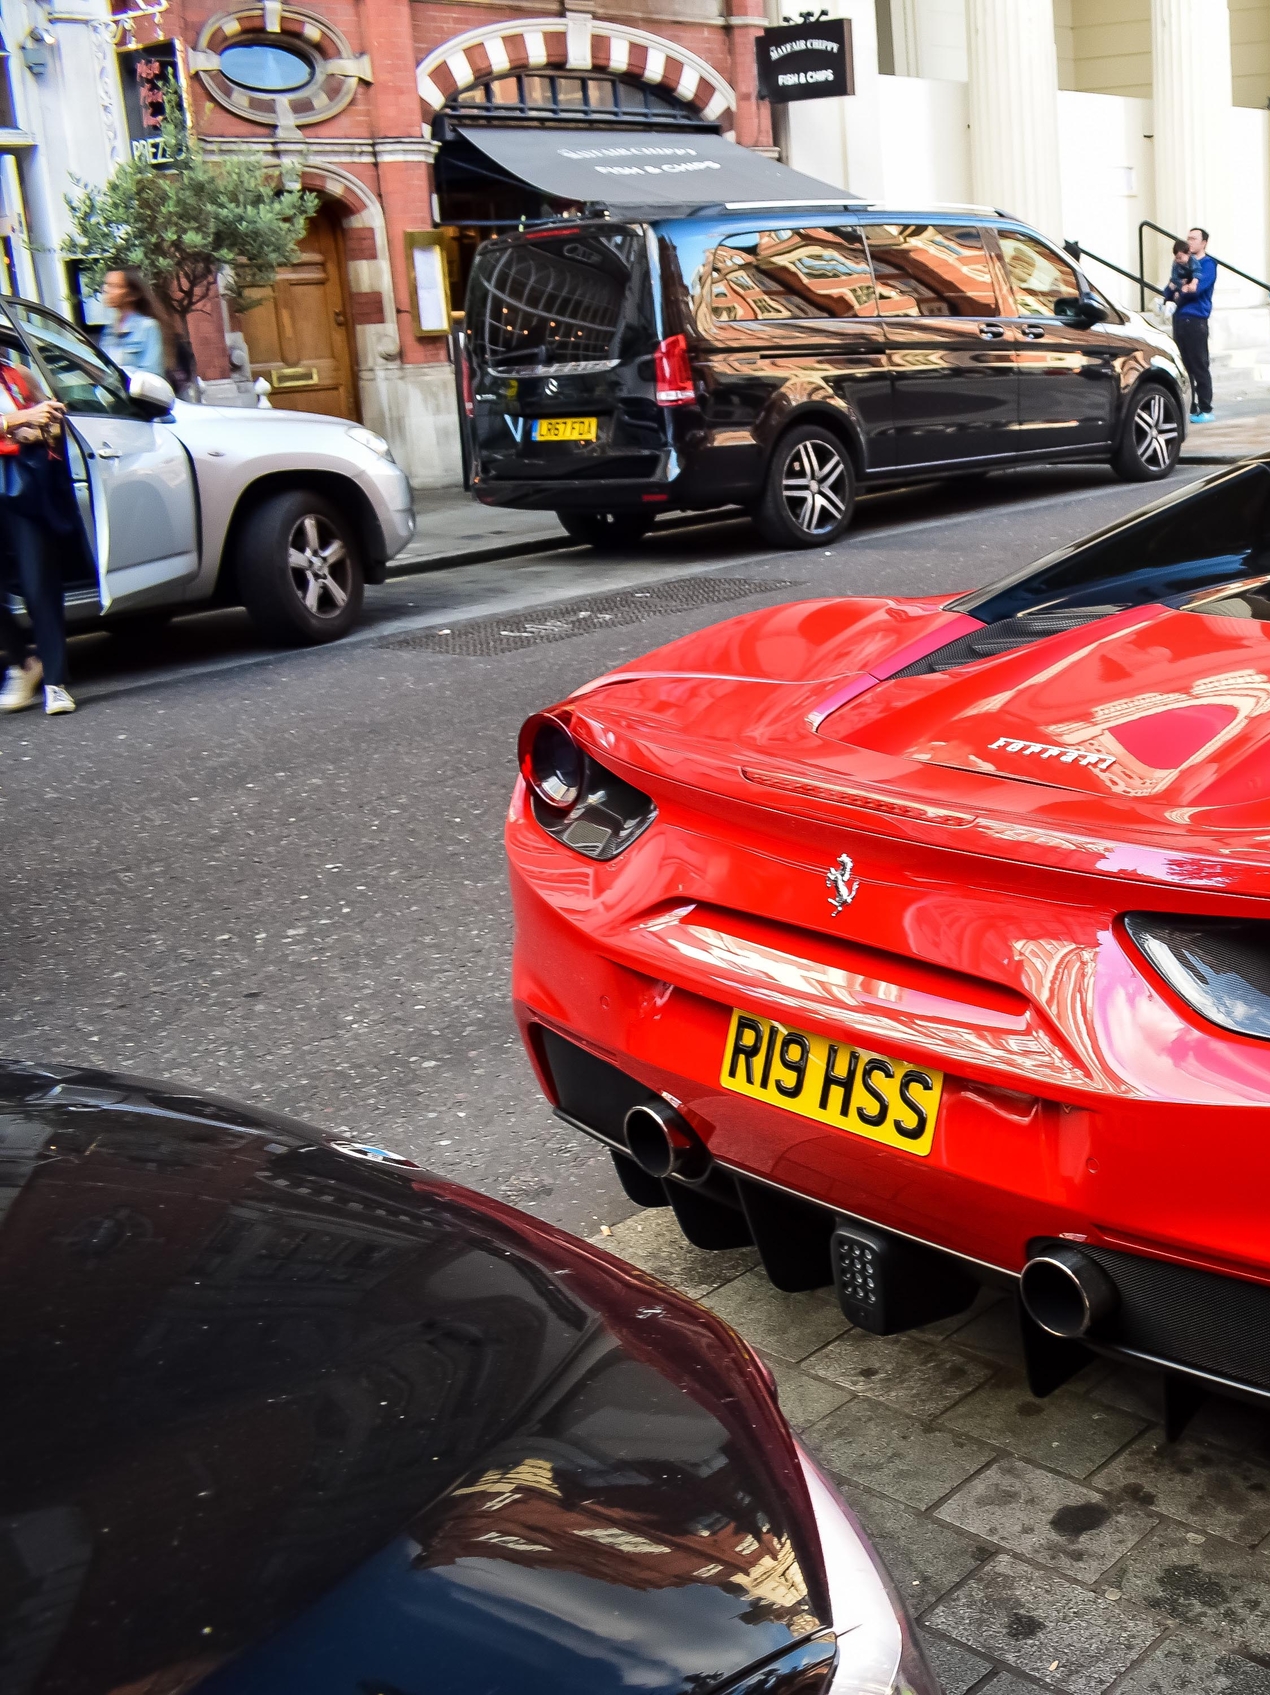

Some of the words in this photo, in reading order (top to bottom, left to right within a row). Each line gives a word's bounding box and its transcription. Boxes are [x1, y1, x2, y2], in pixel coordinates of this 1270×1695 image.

[778, 73, 798, 86] FISH
[799, 72, 806, 84] &
[807, 69, 834, 83] CHIPS
[728, 1015, 810, 1099] R19
[818, 1043, 933, 1141] HSS
